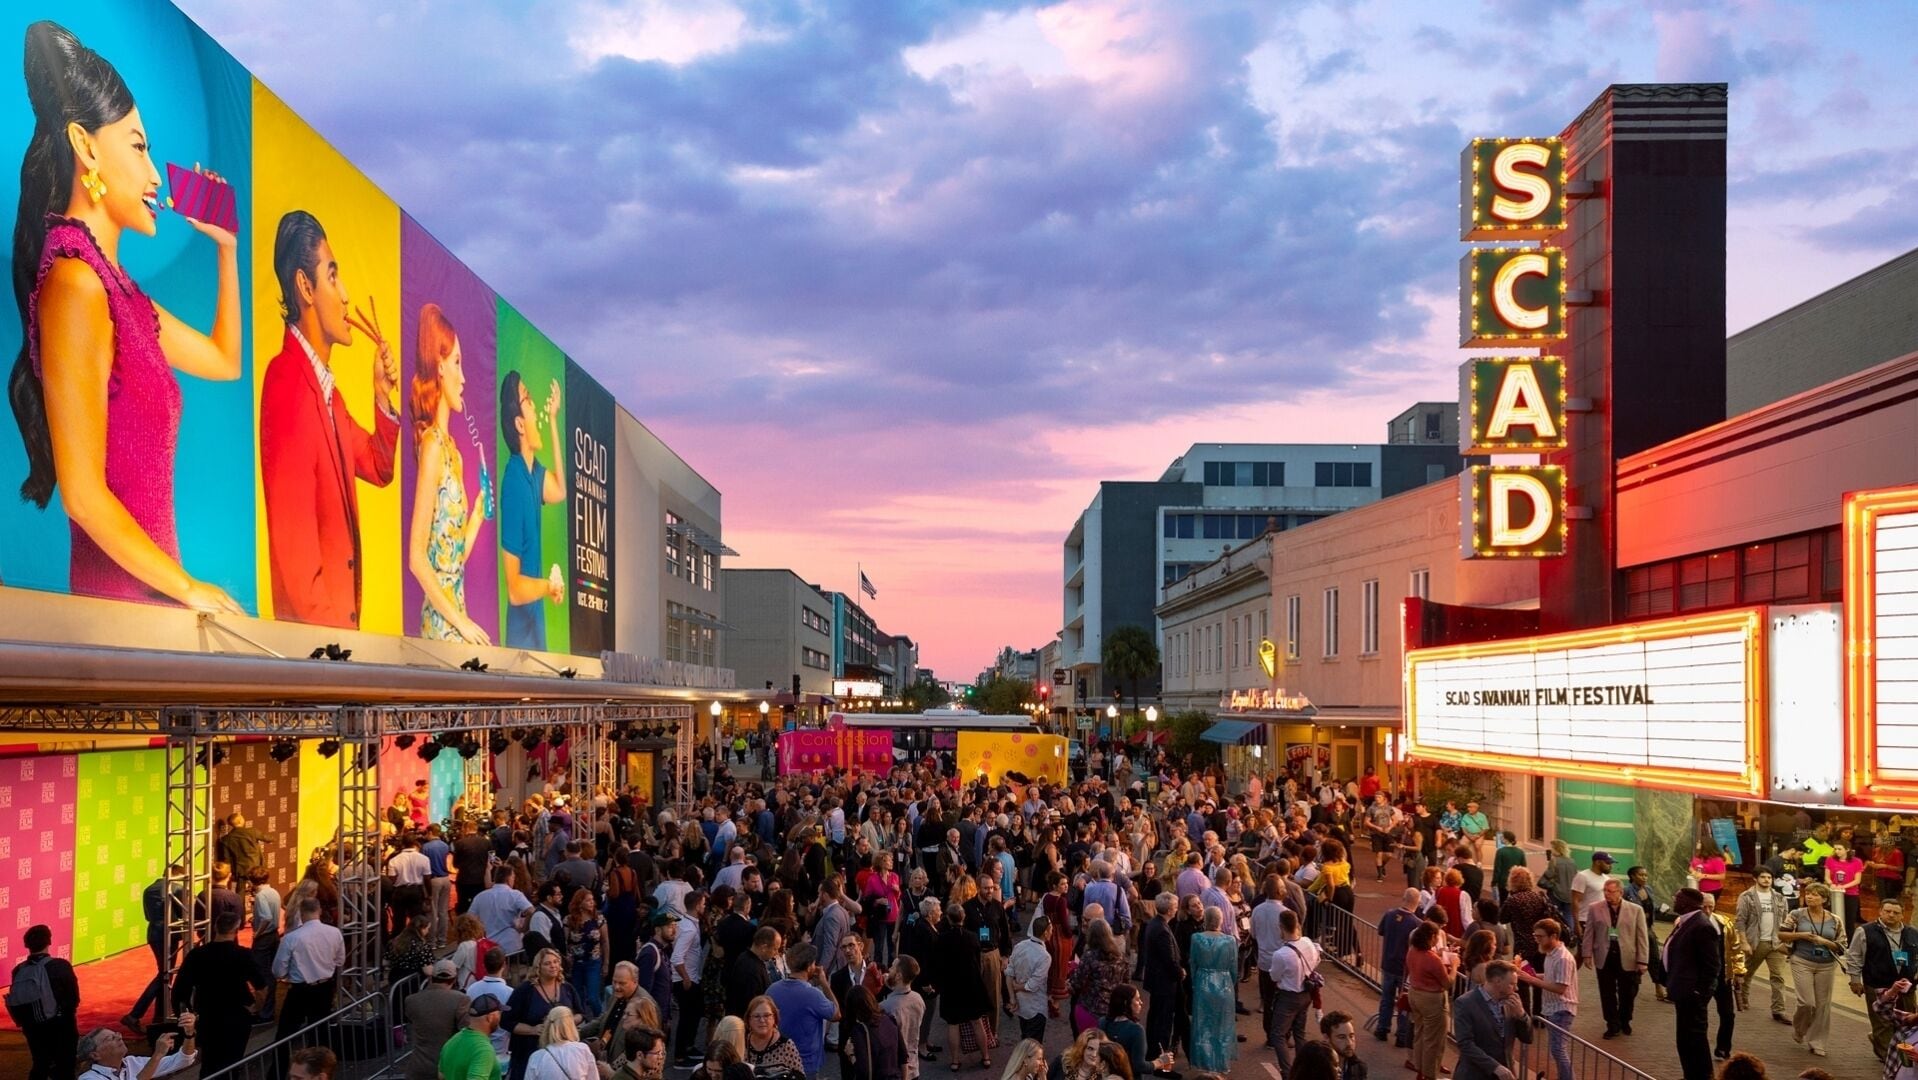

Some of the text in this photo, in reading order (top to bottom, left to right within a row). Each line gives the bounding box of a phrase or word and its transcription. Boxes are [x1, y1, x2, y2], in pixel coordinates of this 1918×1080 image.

[1485, 142, 1558, 548] SCAD
[575, 427, 607, 484] SCAD
[575, 471, 607, 505] SAVANNAH
[575, 493, 607, 552] FILM
[576, 544, 609, 581] FESTIVAL
[1445, 683, 1655, 707] SCAD SAVANNAH FILM FESTIVAL
[801, 733, 889, 746] Concession
